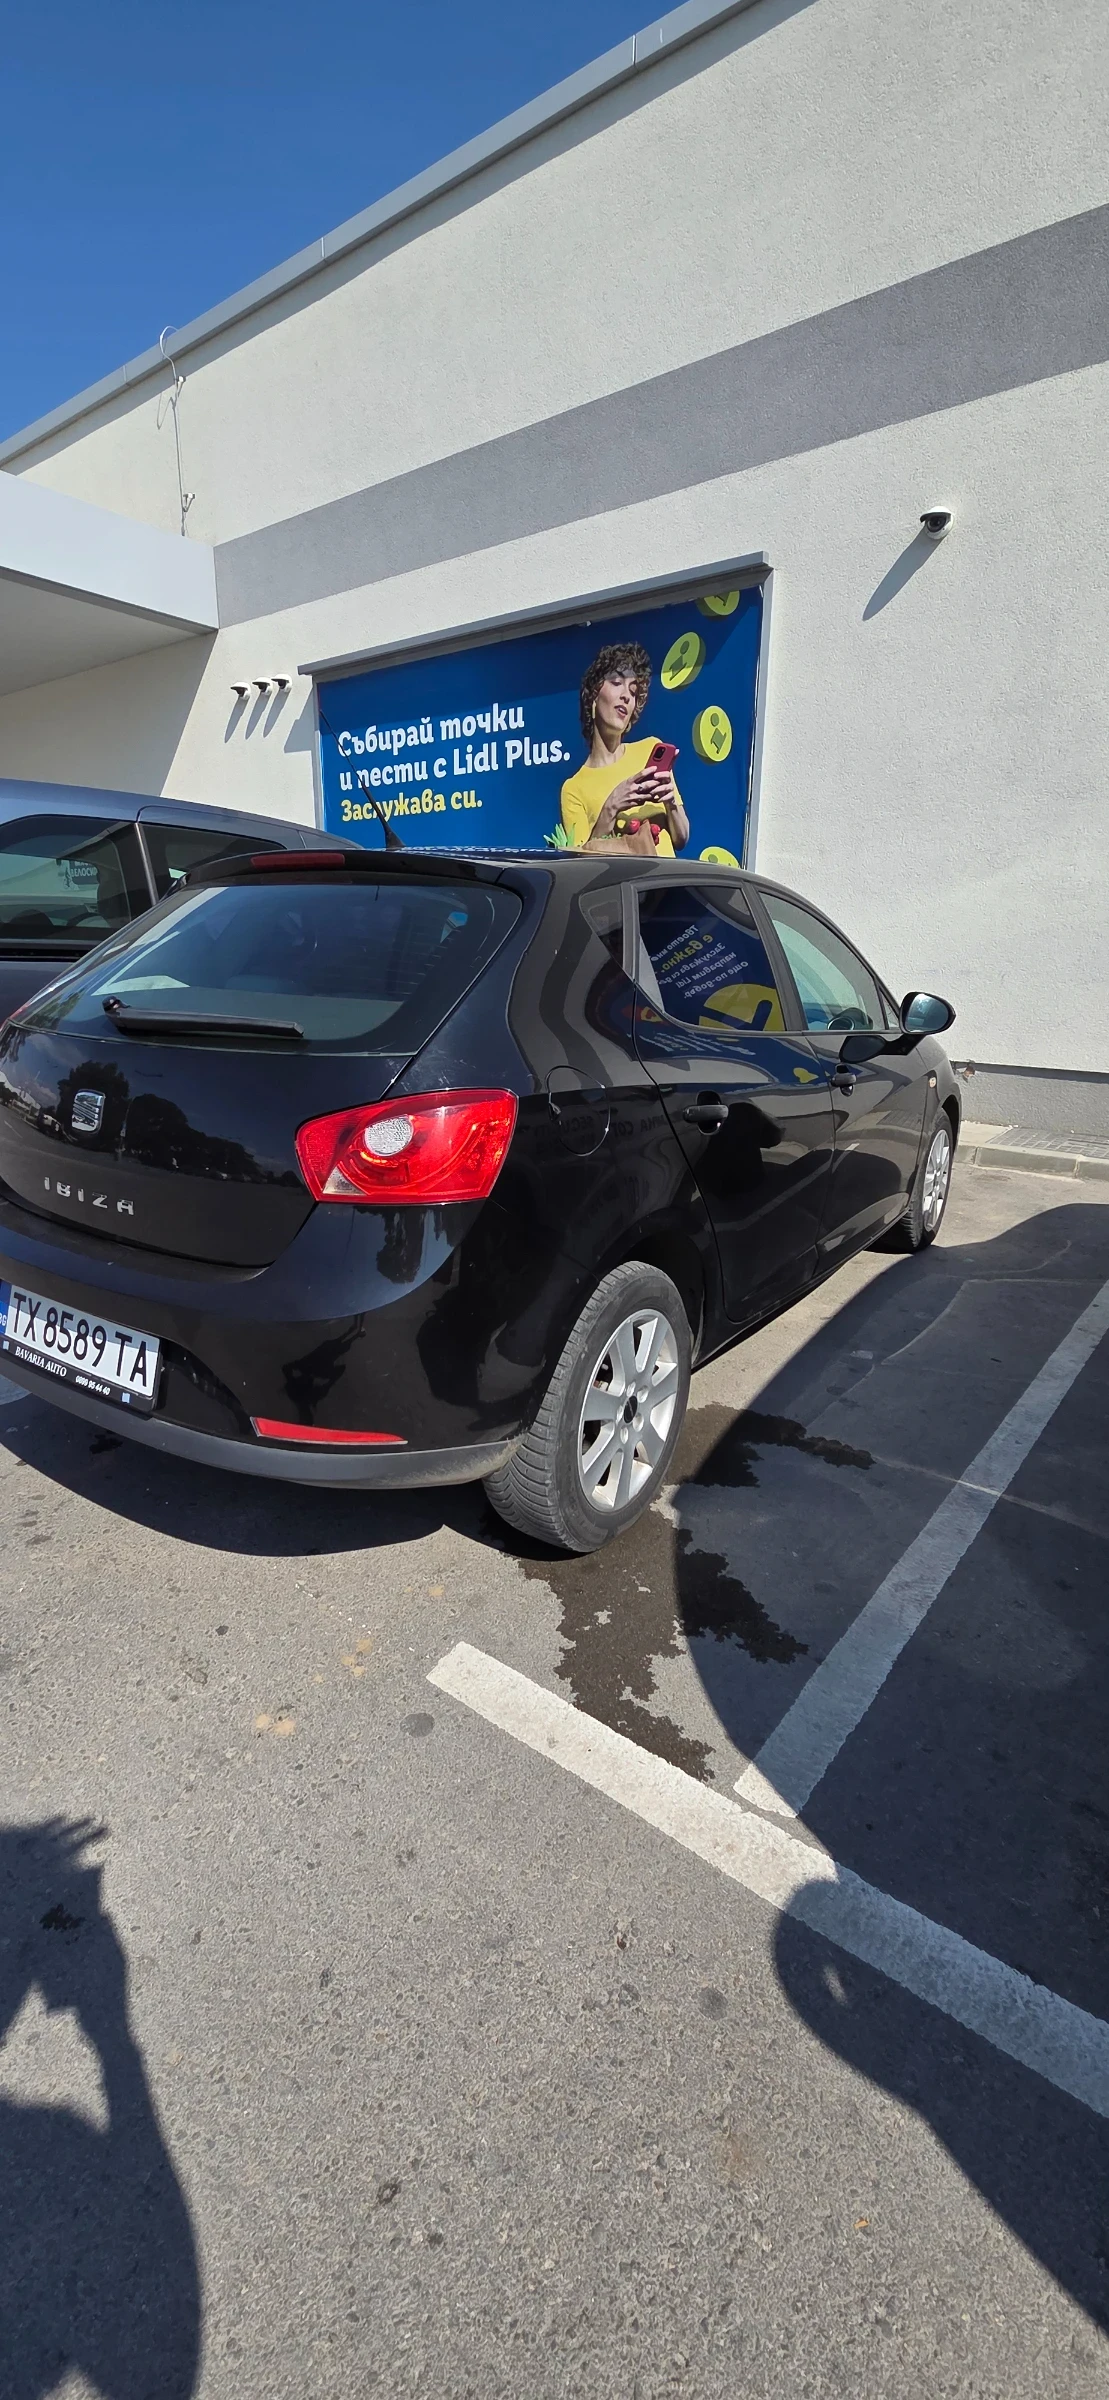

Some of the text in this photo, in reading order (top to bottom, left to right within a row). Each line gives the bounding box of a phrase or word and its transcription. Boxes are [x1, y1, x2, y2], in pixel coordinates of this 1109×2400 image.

[337, 702, 525, 757] Събирай точки
[339, 736, 570, 791] и пести с Lidl Plus.
[450, 790, 482, 810] си.
[44, 1176, 135, 1216] IBIZA
[13, 1291, 148, 1388] TX 8589 TA
[14, 1345, 45, 1369] BAVARIA
[45, 1360, 68, 1377] AUTO
